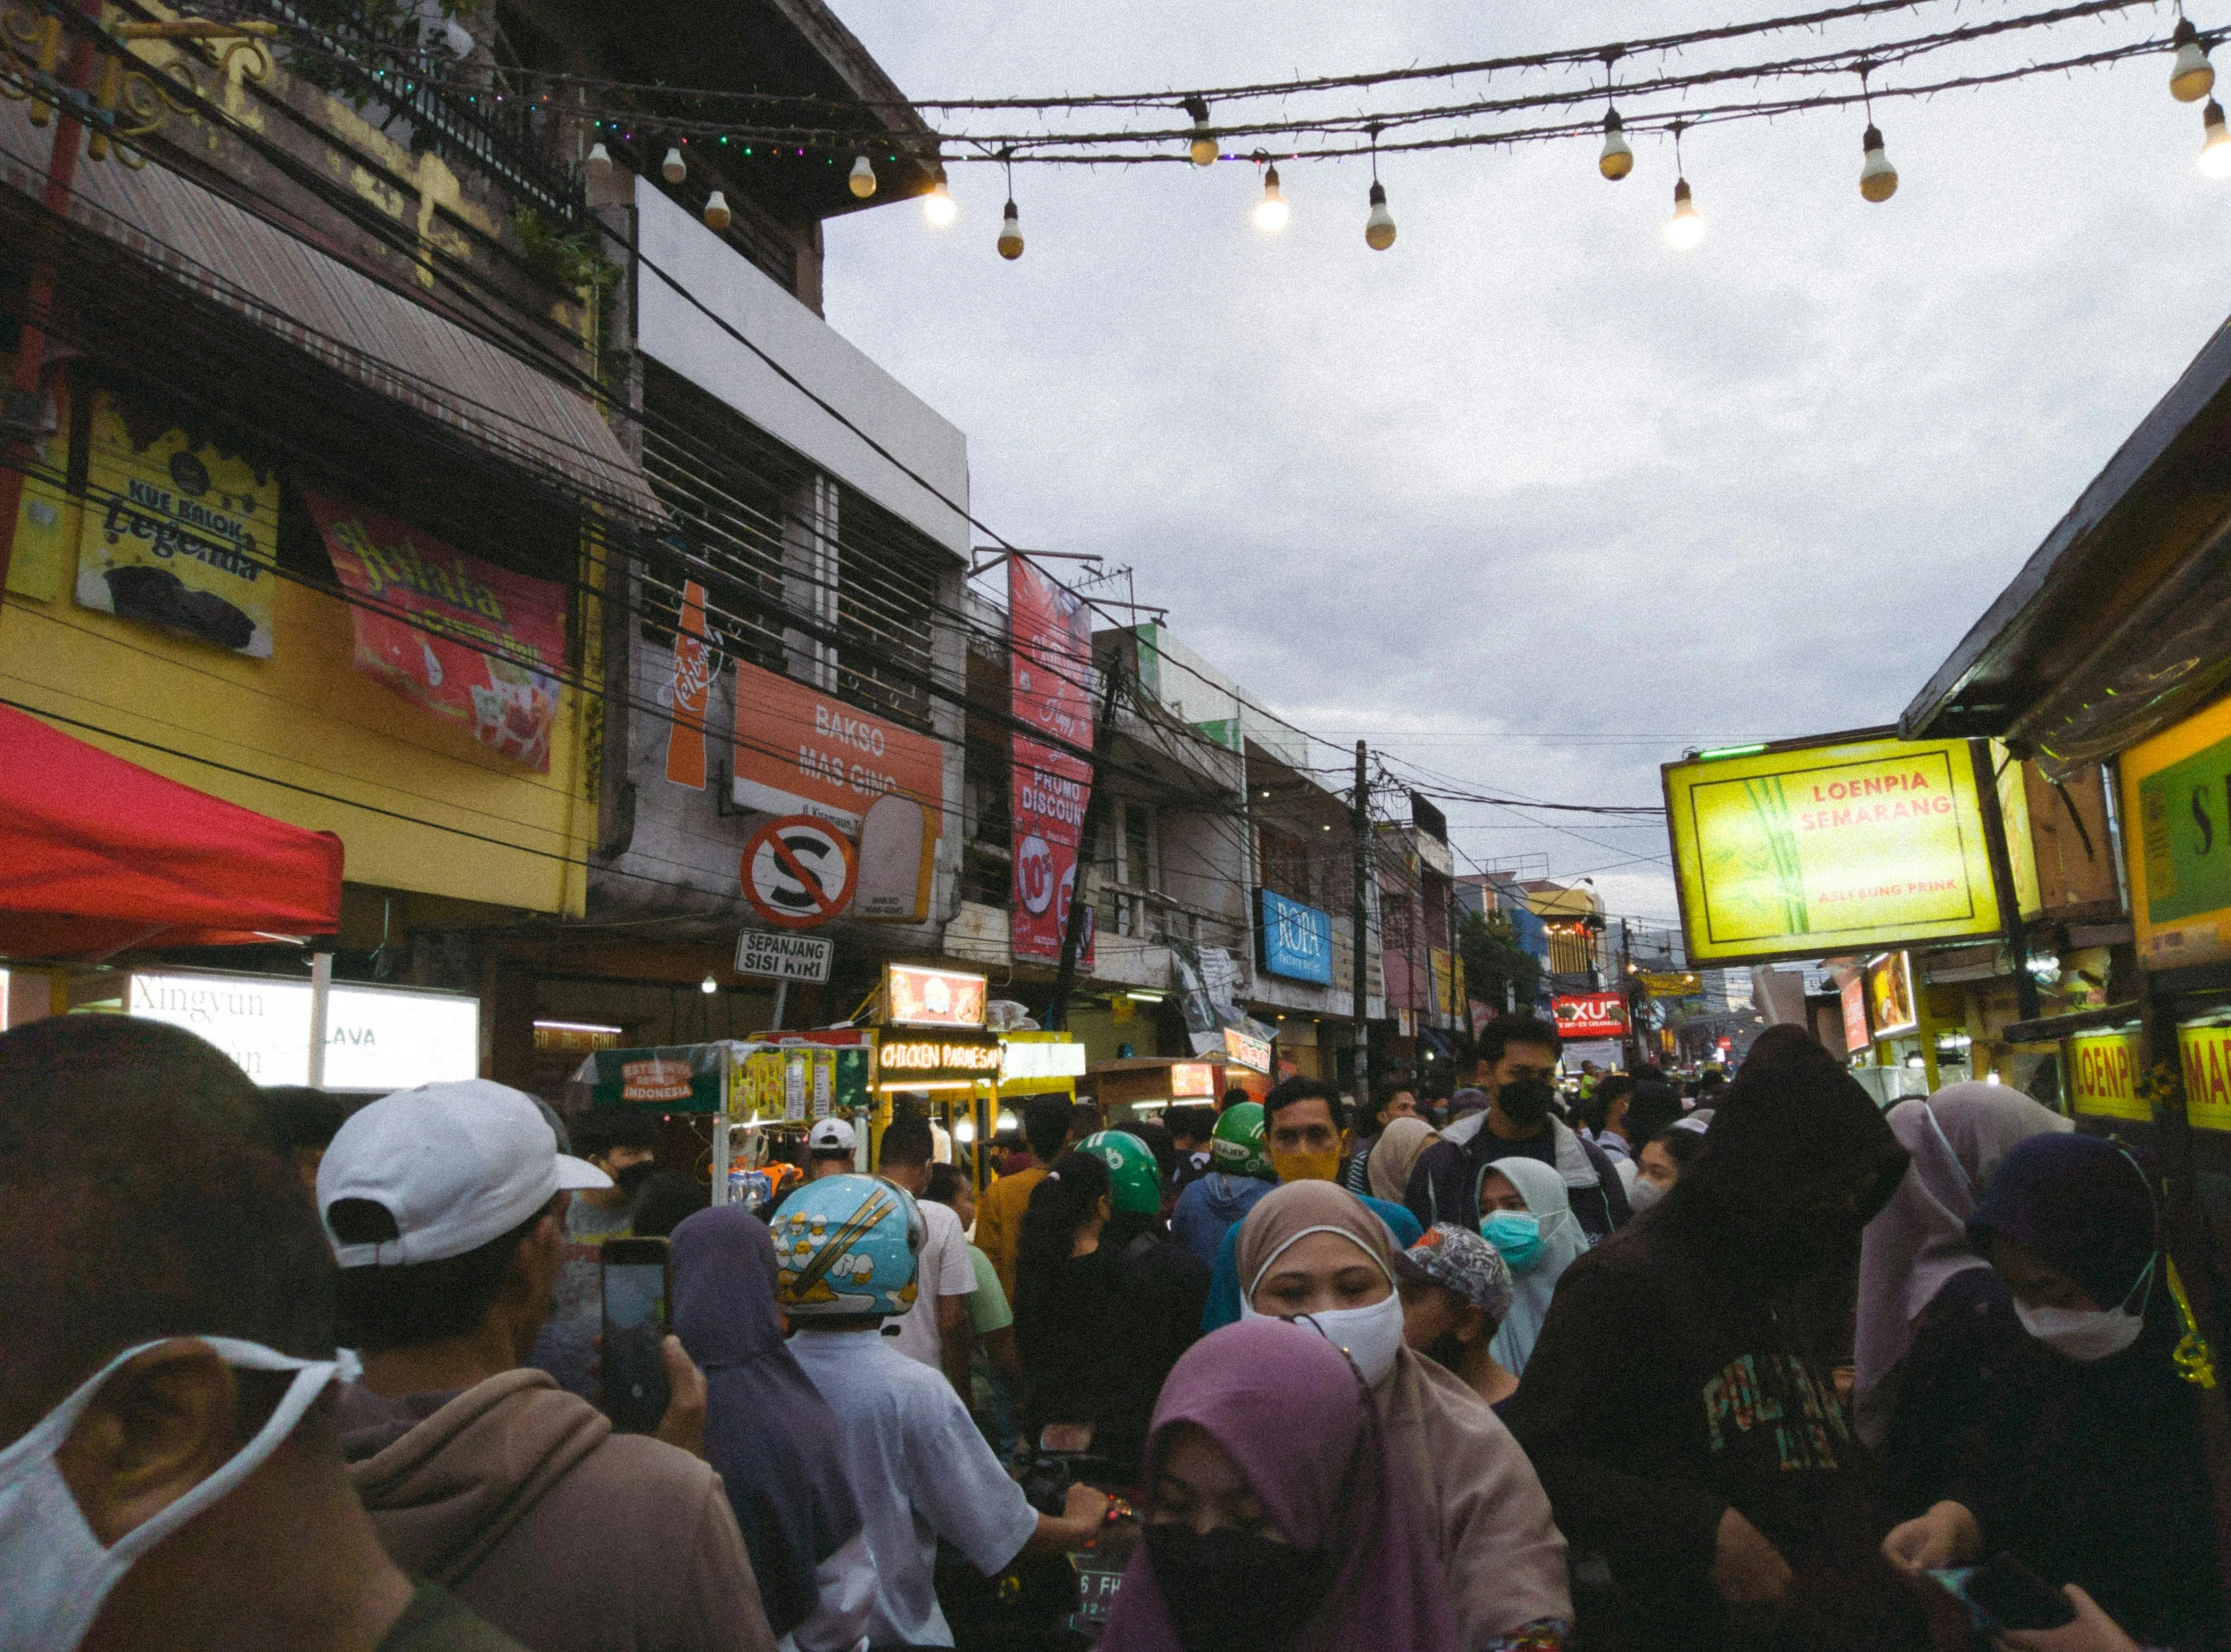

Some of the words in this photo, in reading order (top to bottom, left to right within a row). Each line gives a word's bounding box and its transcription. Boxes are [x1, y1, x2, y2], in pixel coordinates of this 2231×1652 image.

[815, 704, 885, 757] BAKSO
[799, 744, 845, 787] MAS
[1034, 765, 1080, 802] PROMO
[1812, 771, 1930, 802] LOENPIA
[1801, 796, 1953, 832] SEMARANG
[1277, 902, 1320, 957] ROPA
[746, 933, 825, 960] SEPANJANG
[744, 952, 780, 972] SISI
[784, 957, 821, 978] KIRI
[326, 1025, 377, 1047] AVA
[880, 1041, 940, 1070] CHICKEN
[2073, 1045, 2140, 1099] LOENPI
[624, 1084, 692, 1100] INDONESIA
